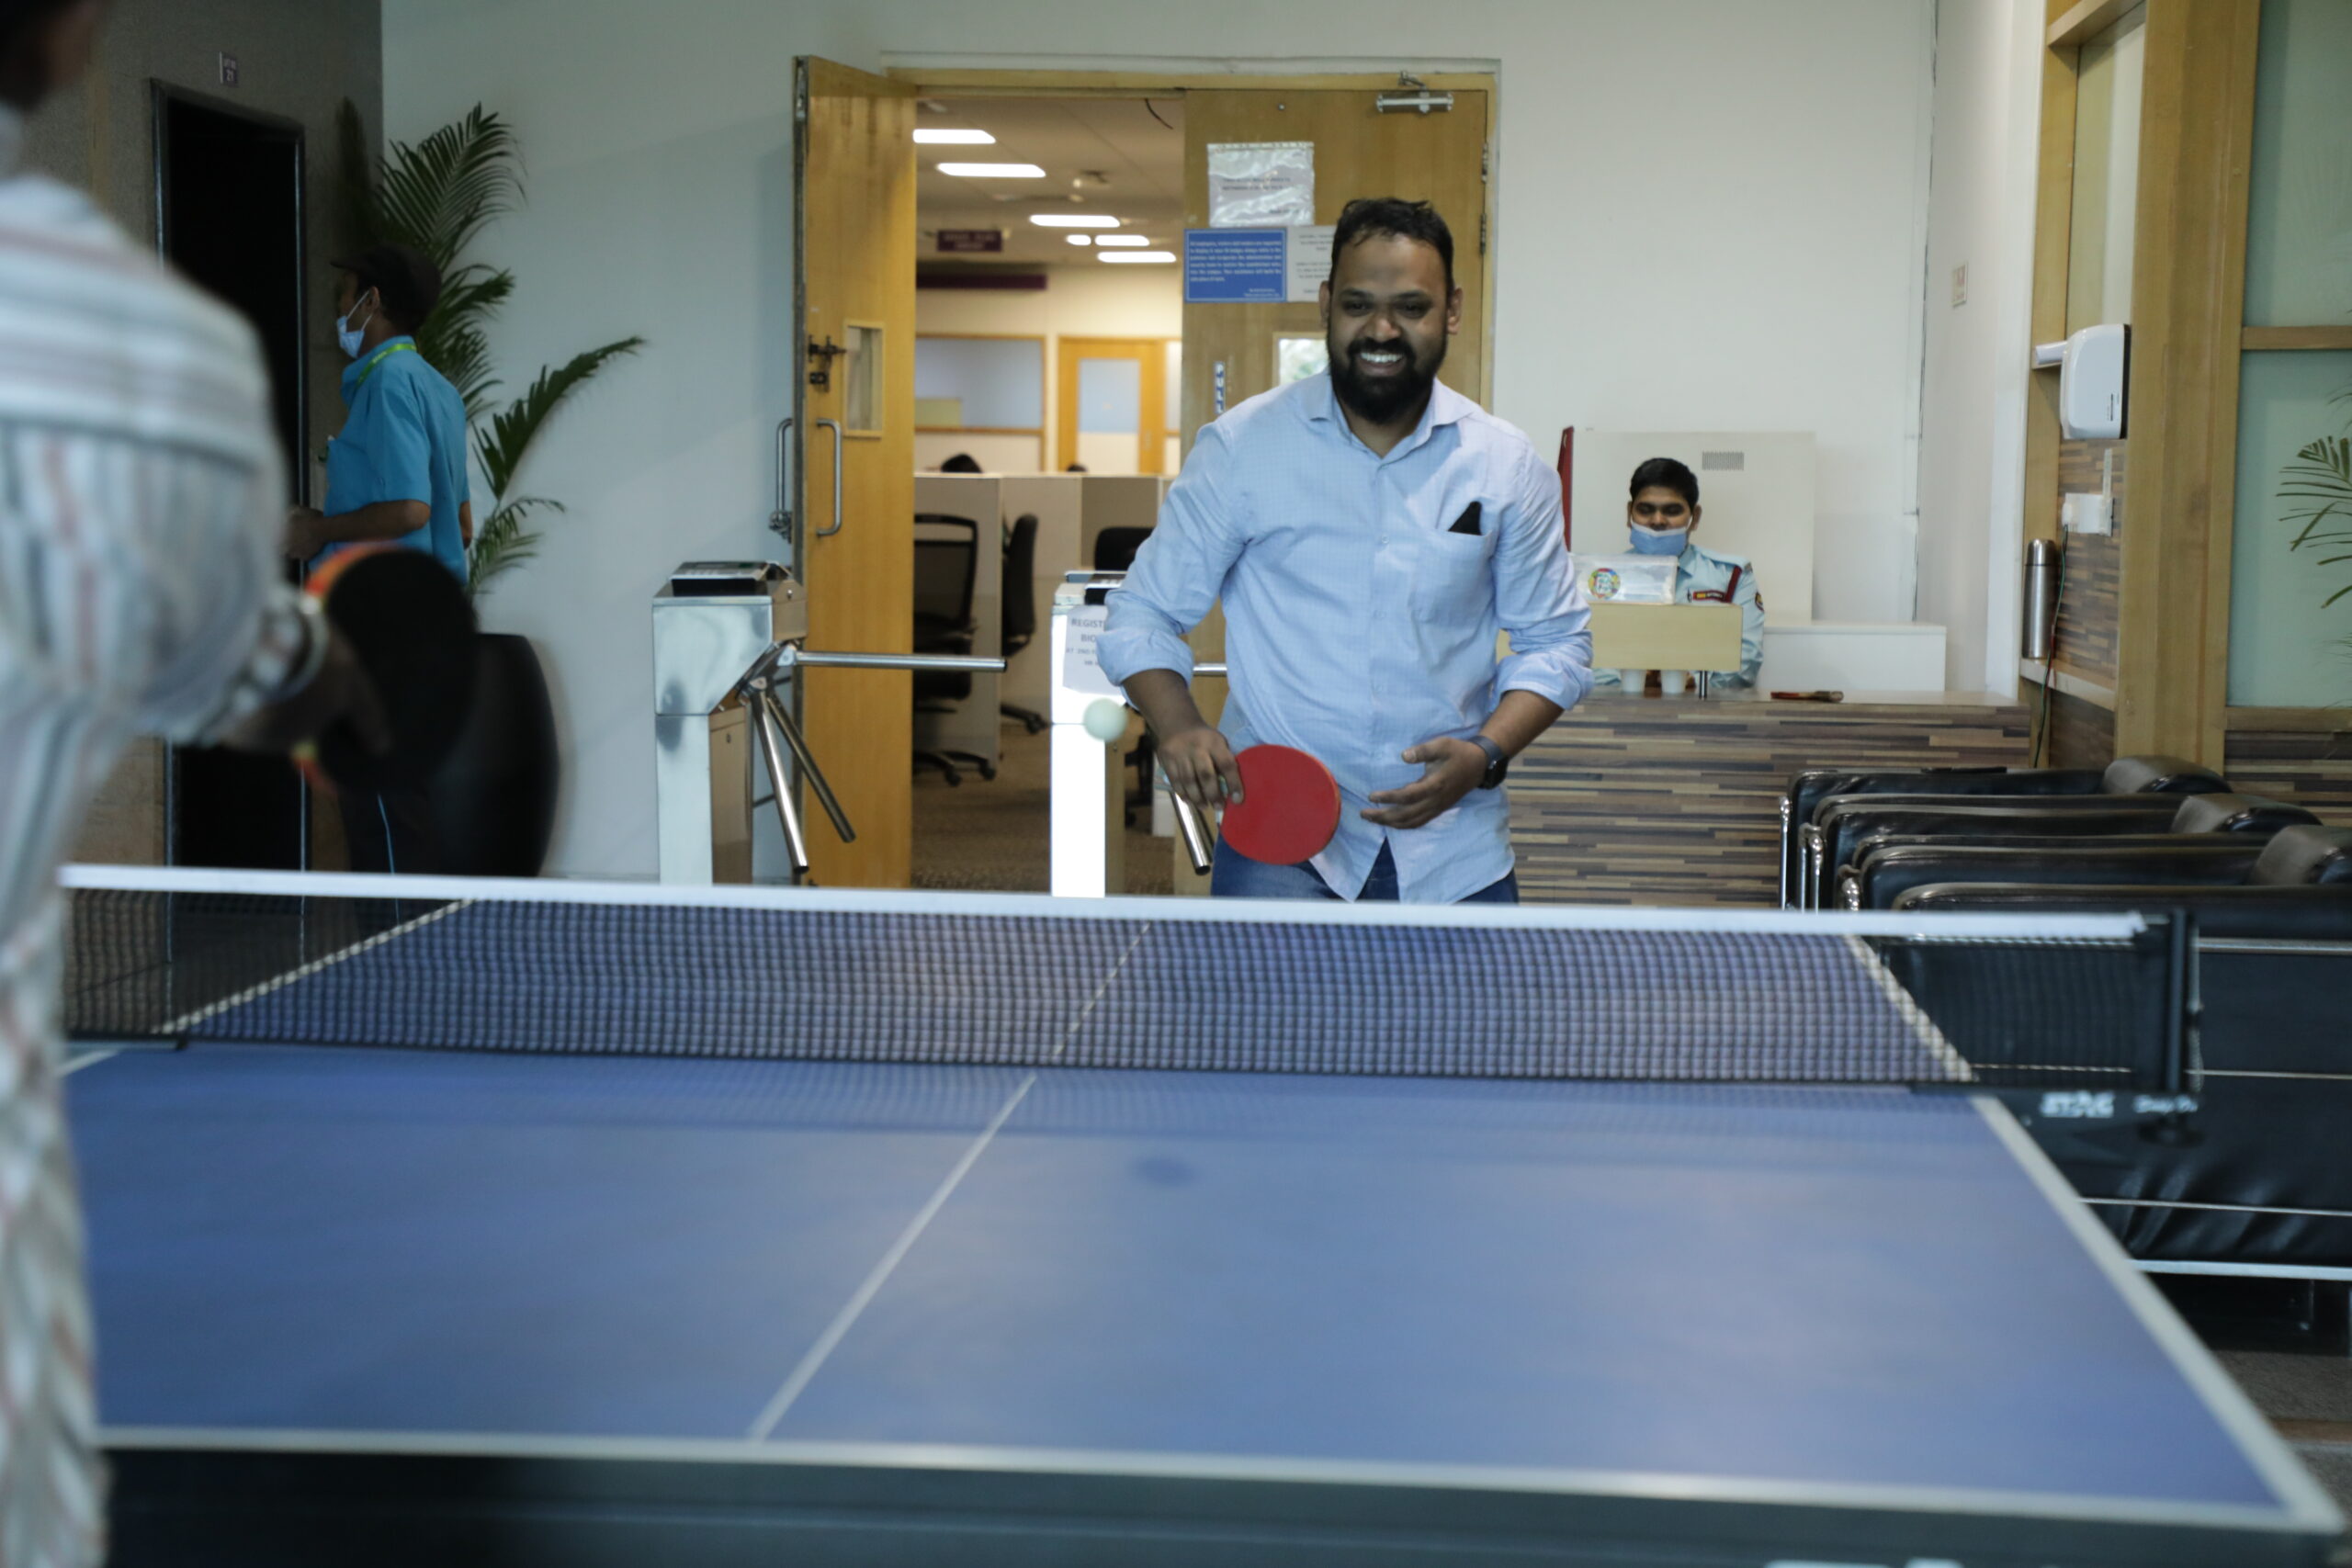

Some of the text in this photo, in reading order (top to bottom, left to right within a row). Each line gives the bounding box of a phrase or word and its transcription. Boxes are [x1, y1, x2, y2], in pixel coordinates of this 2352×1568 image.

[1216, 364, 1224, 413] PULL
[1071, 618, 1103, 627] REGIST
[1080, 634, 1097, 642] BIO
